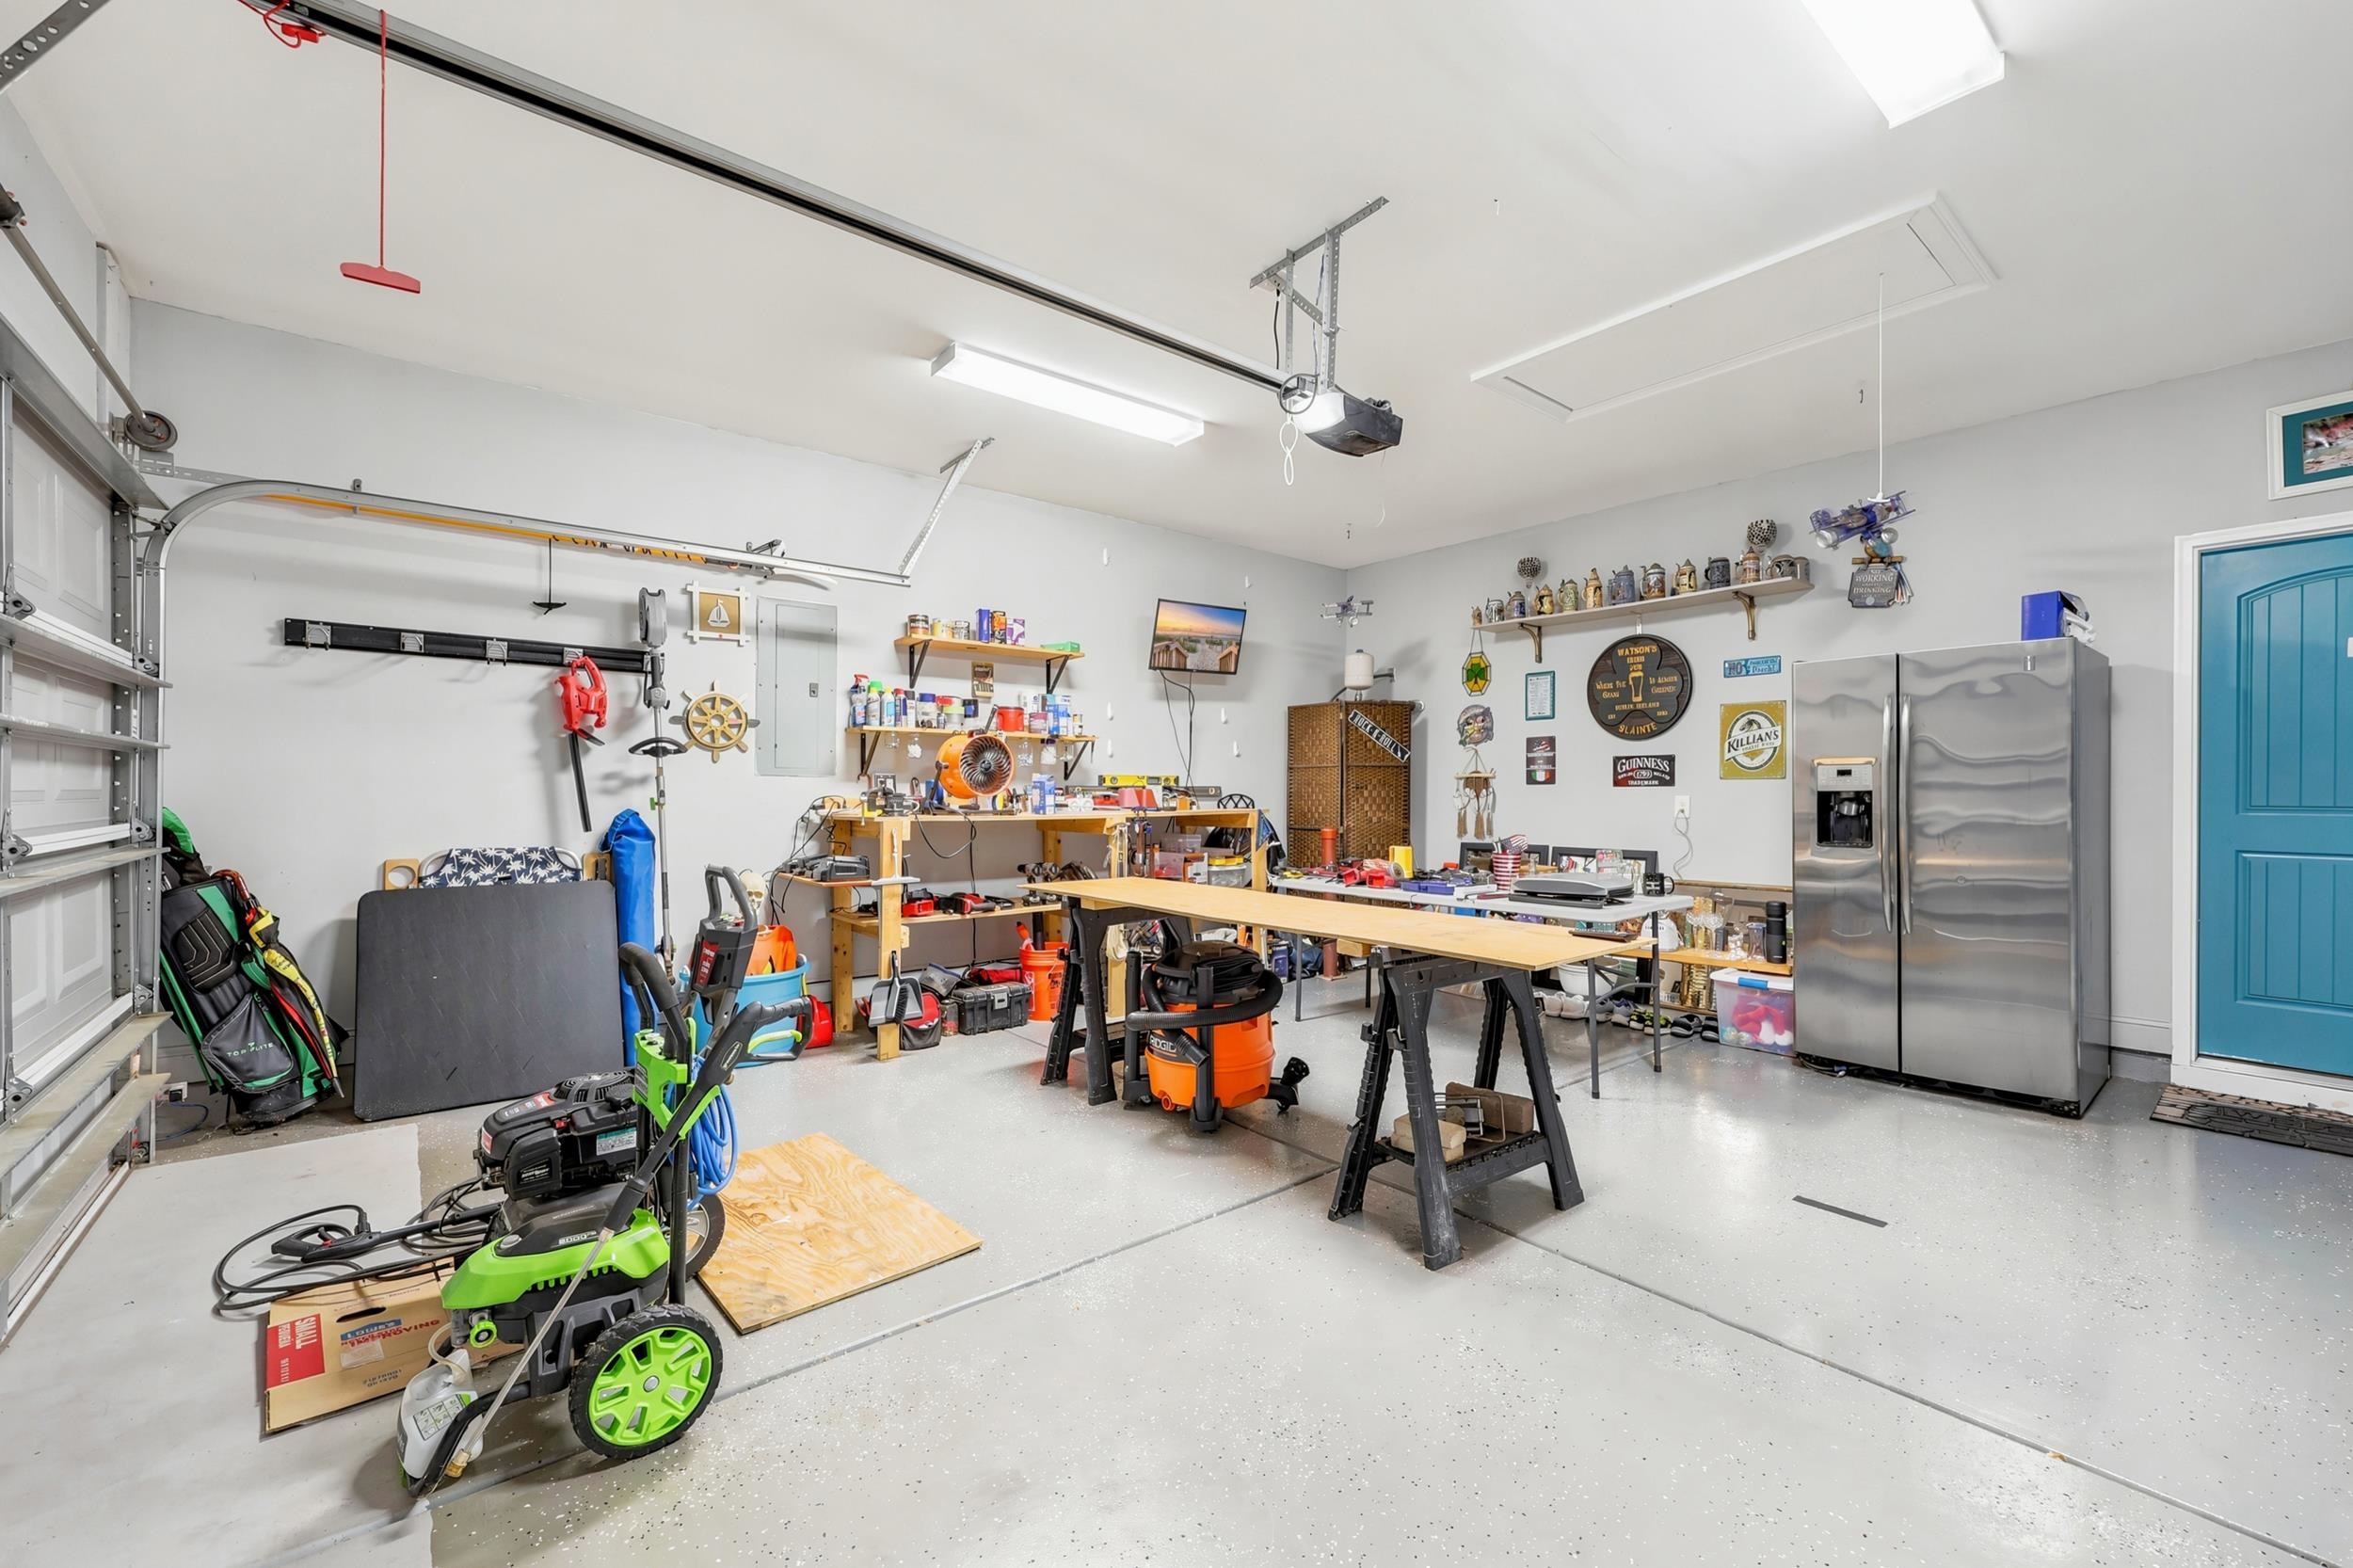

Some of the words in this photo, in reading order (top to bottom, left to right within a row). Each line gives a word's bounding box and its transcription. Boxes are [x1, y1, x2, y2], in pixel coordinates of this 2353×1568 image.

[1617, 645, 1657, 656] WATSON'S
[1619, 722, 1657, 735] SLAINTE
[1617, 757, 1670, 773] GUINNESS
[1149, 1034, 1177, 1053] RIDGID
[295, 1317, 317, 1350] SMALL
[346, 1321, 396, 1340] LOWE'S
